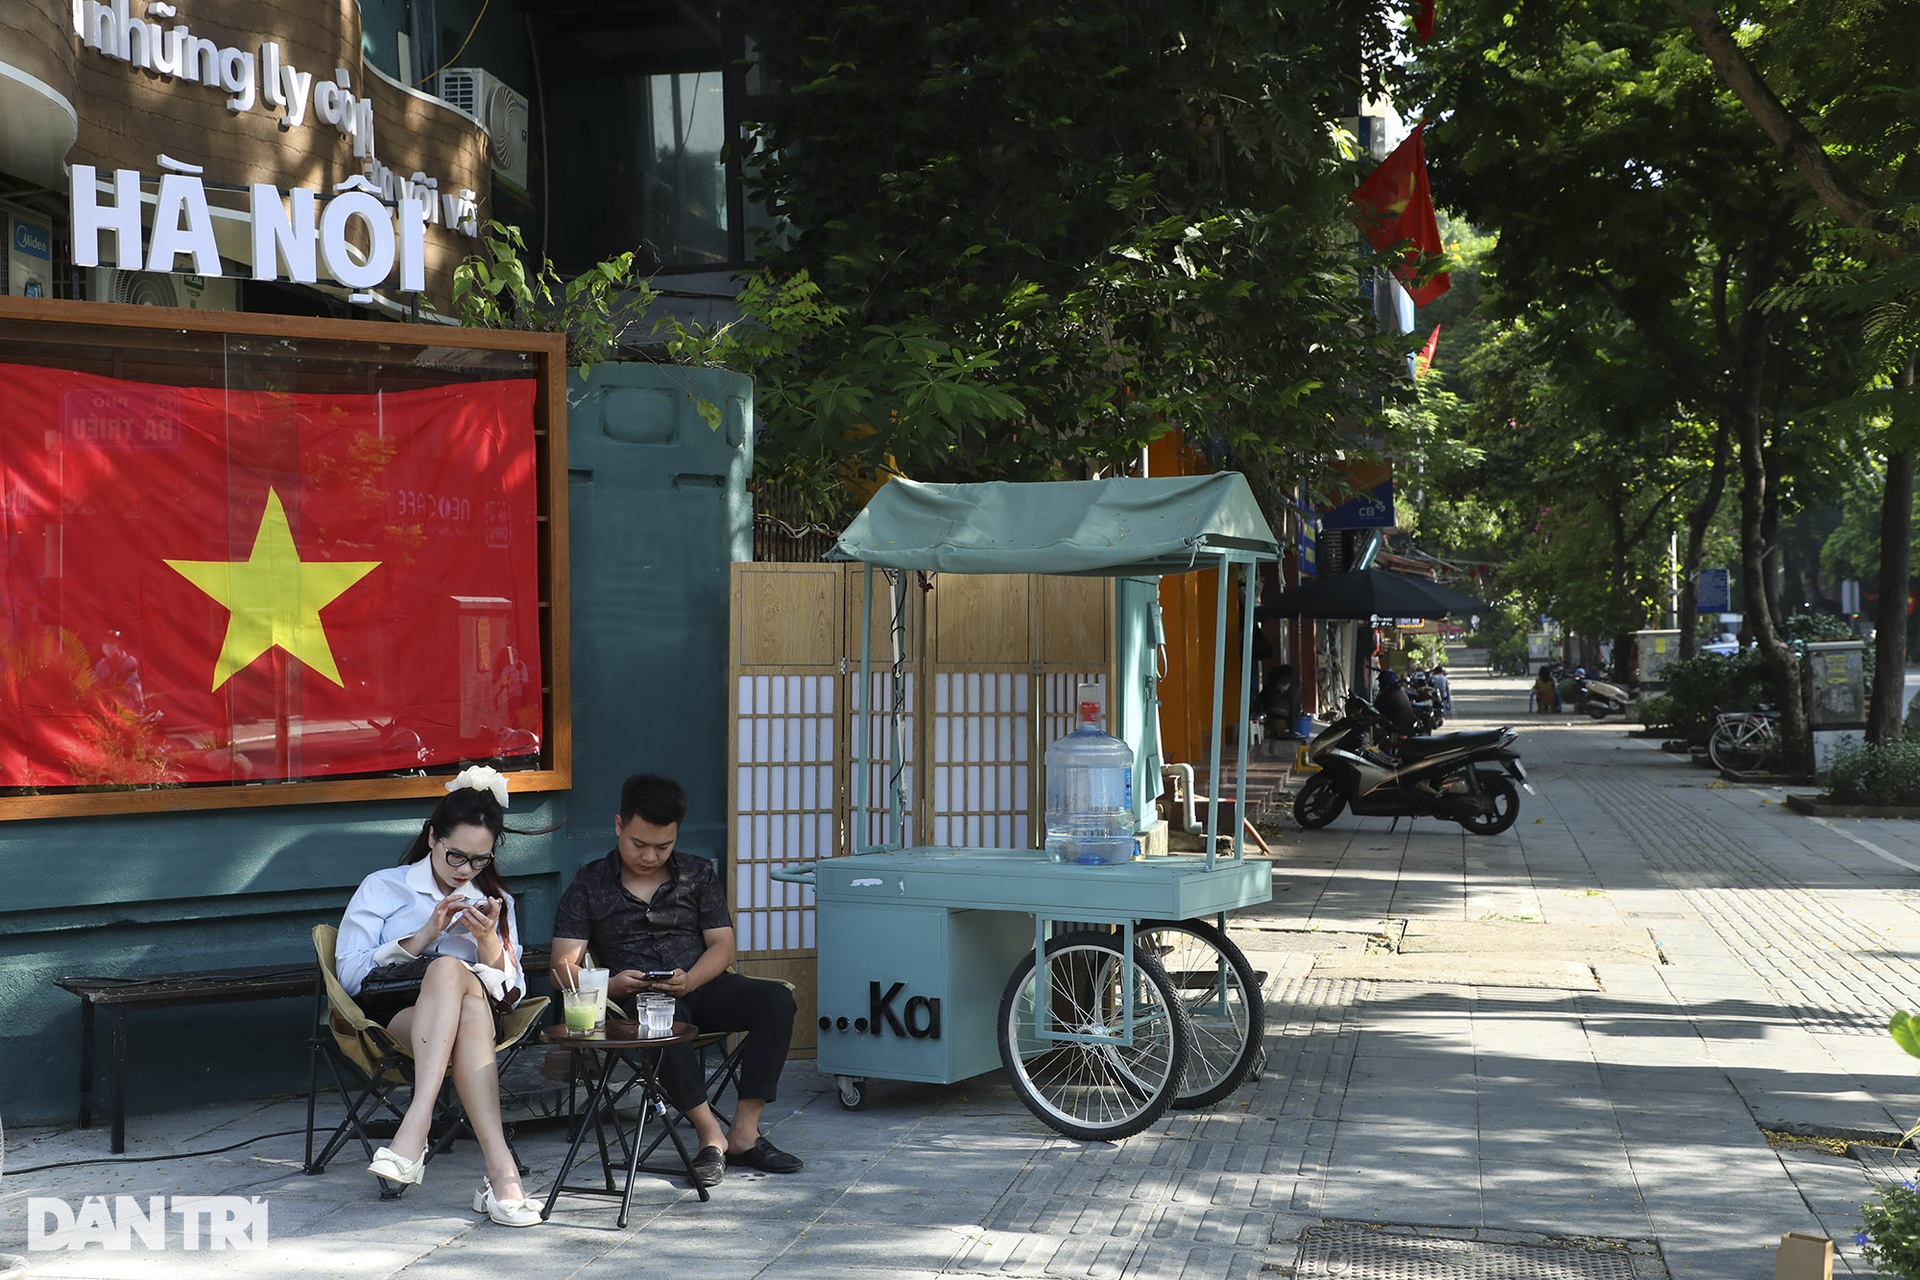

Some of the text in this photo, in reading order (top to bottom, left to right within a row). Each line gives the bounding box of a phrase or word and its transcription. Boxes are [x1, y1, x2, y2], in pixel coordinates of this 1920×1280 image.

[84, 0, 255, 111] những
[262, 42, 312, 127] ly
[17, 225, 47, 252] Midea
[69, 153, 222, 277] HÀ
[251, 174, 425, 304] NỘI
